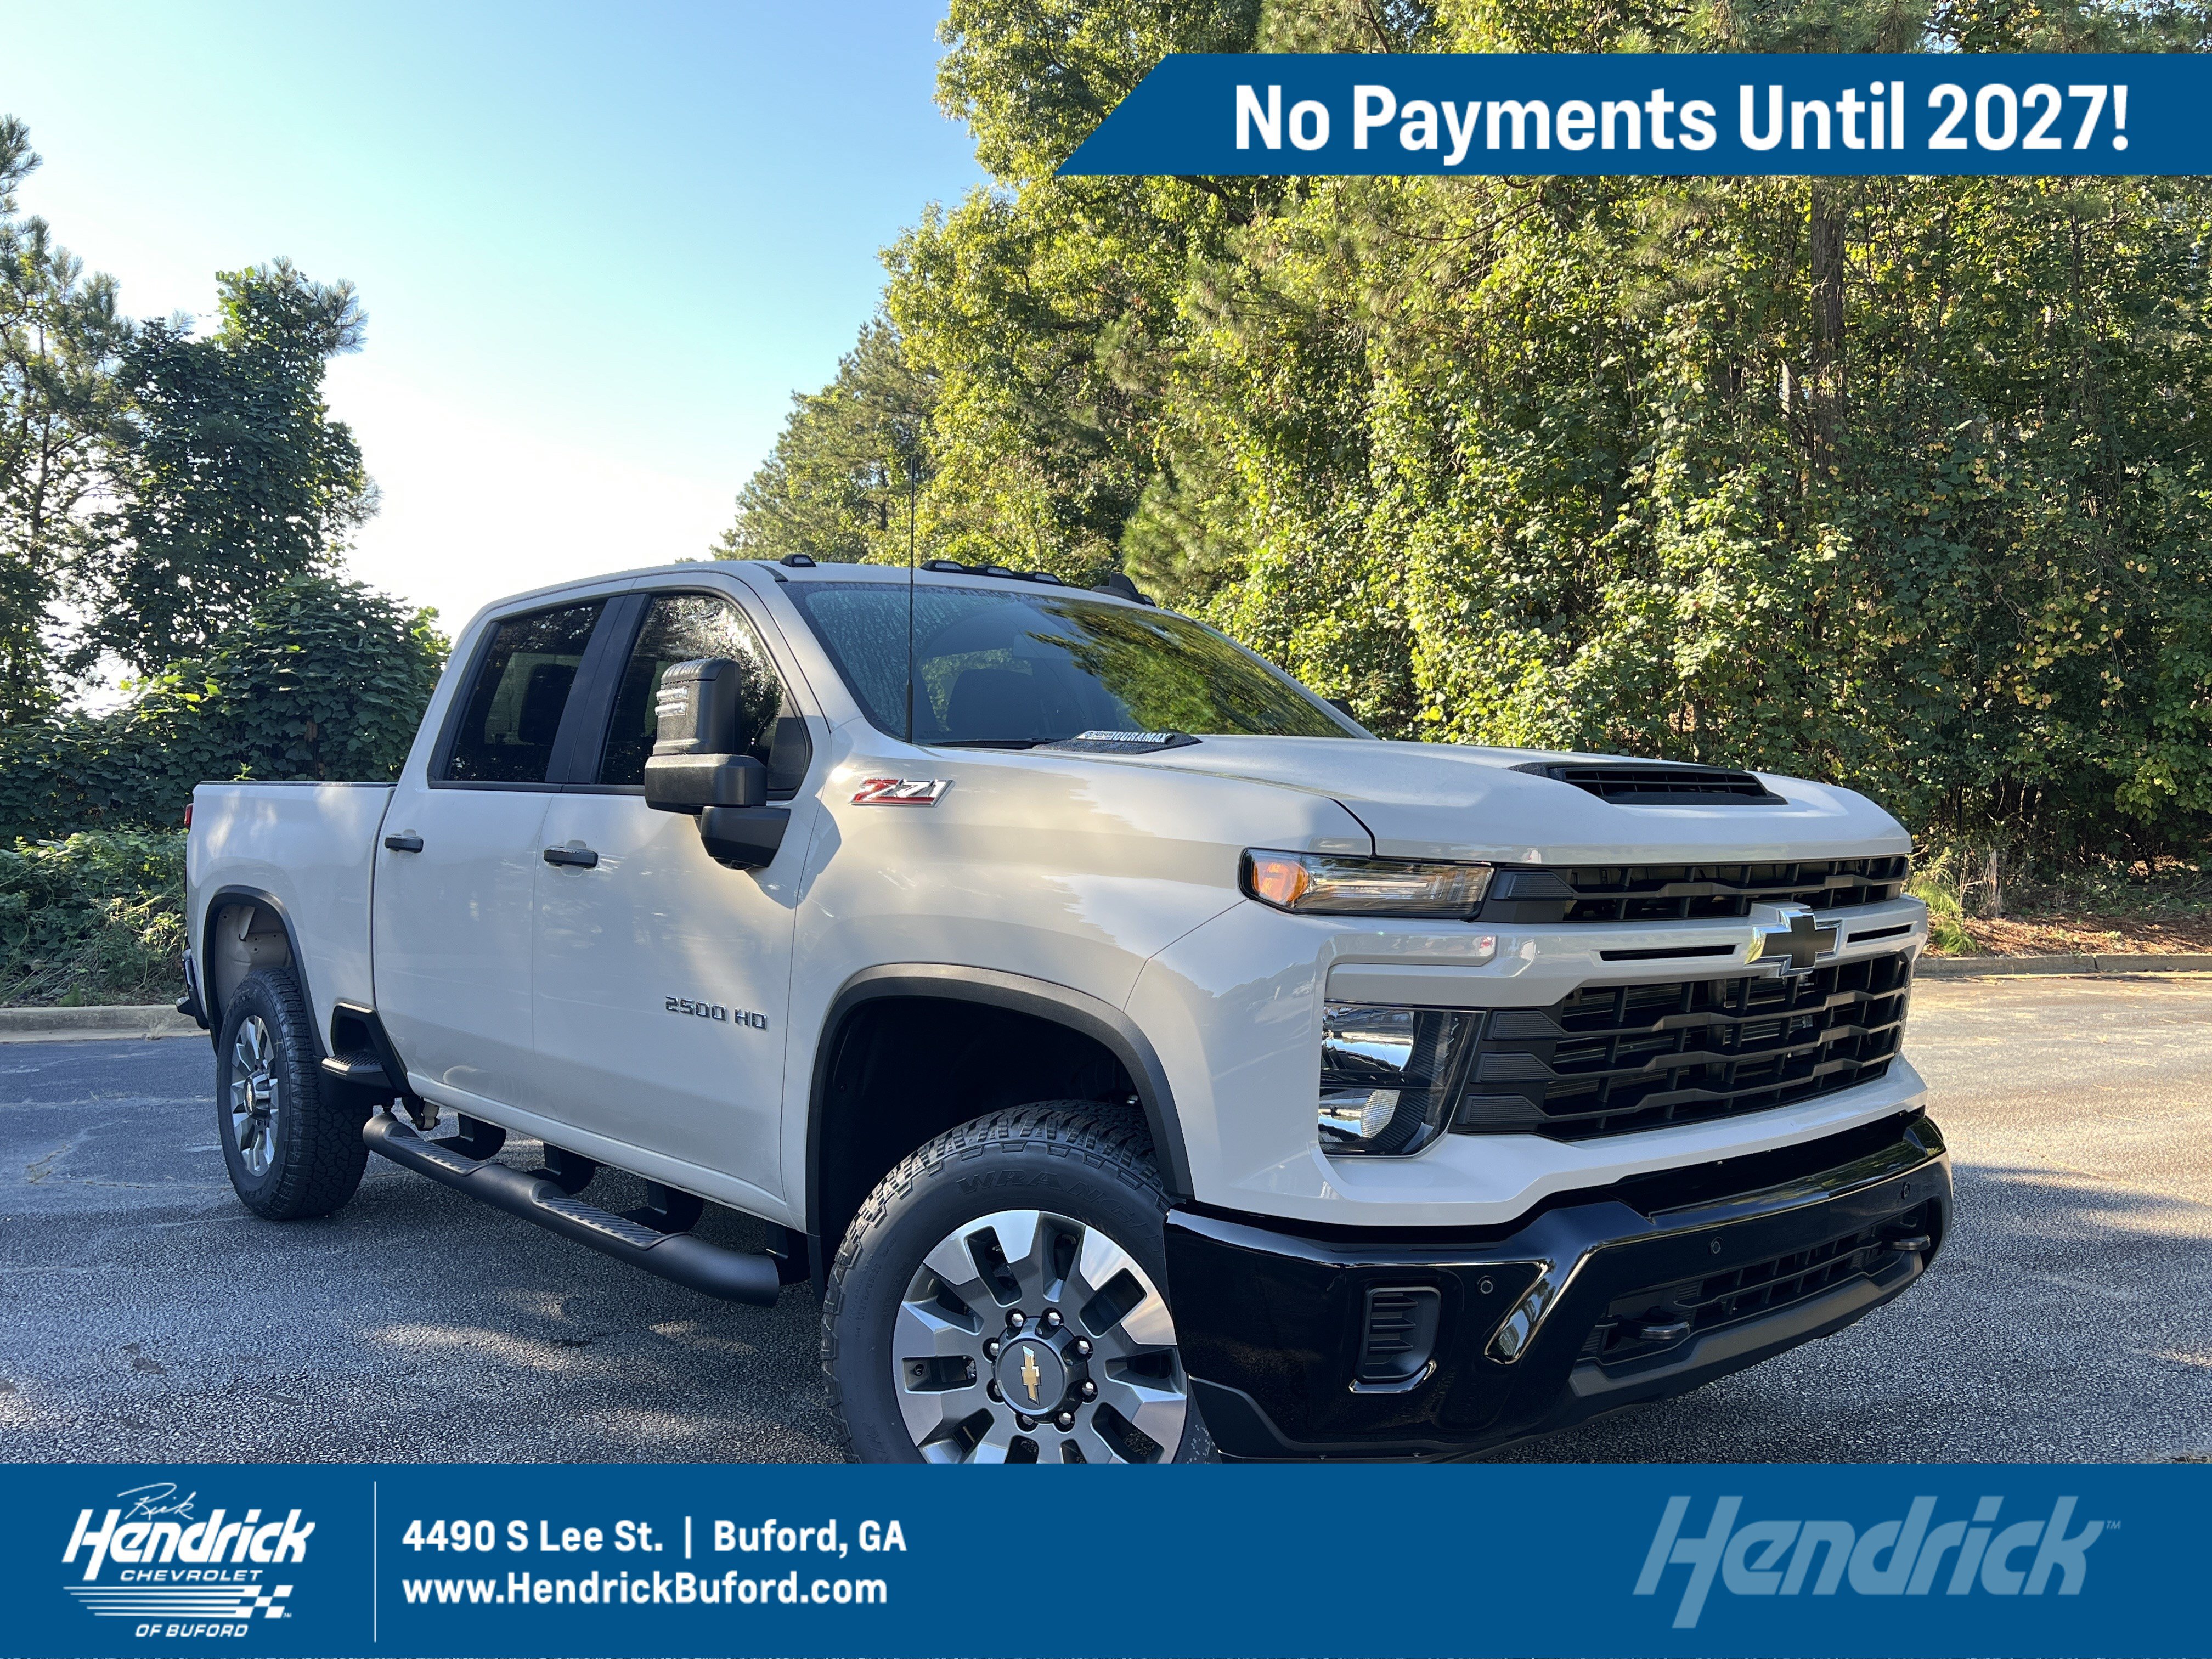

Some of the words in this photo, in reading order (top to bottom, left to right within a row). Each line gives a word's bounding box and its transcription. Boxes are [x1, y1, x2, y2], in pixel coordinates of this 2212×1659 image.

[1112, 732, 1169, 744] DURAMAX
[851, 777, 953, 806] Z71
[665, 995, 727, 1022] 2500
[734, 1008, 768, 1030] HD
[956, 1170, 1163, 1259] WRANGL
